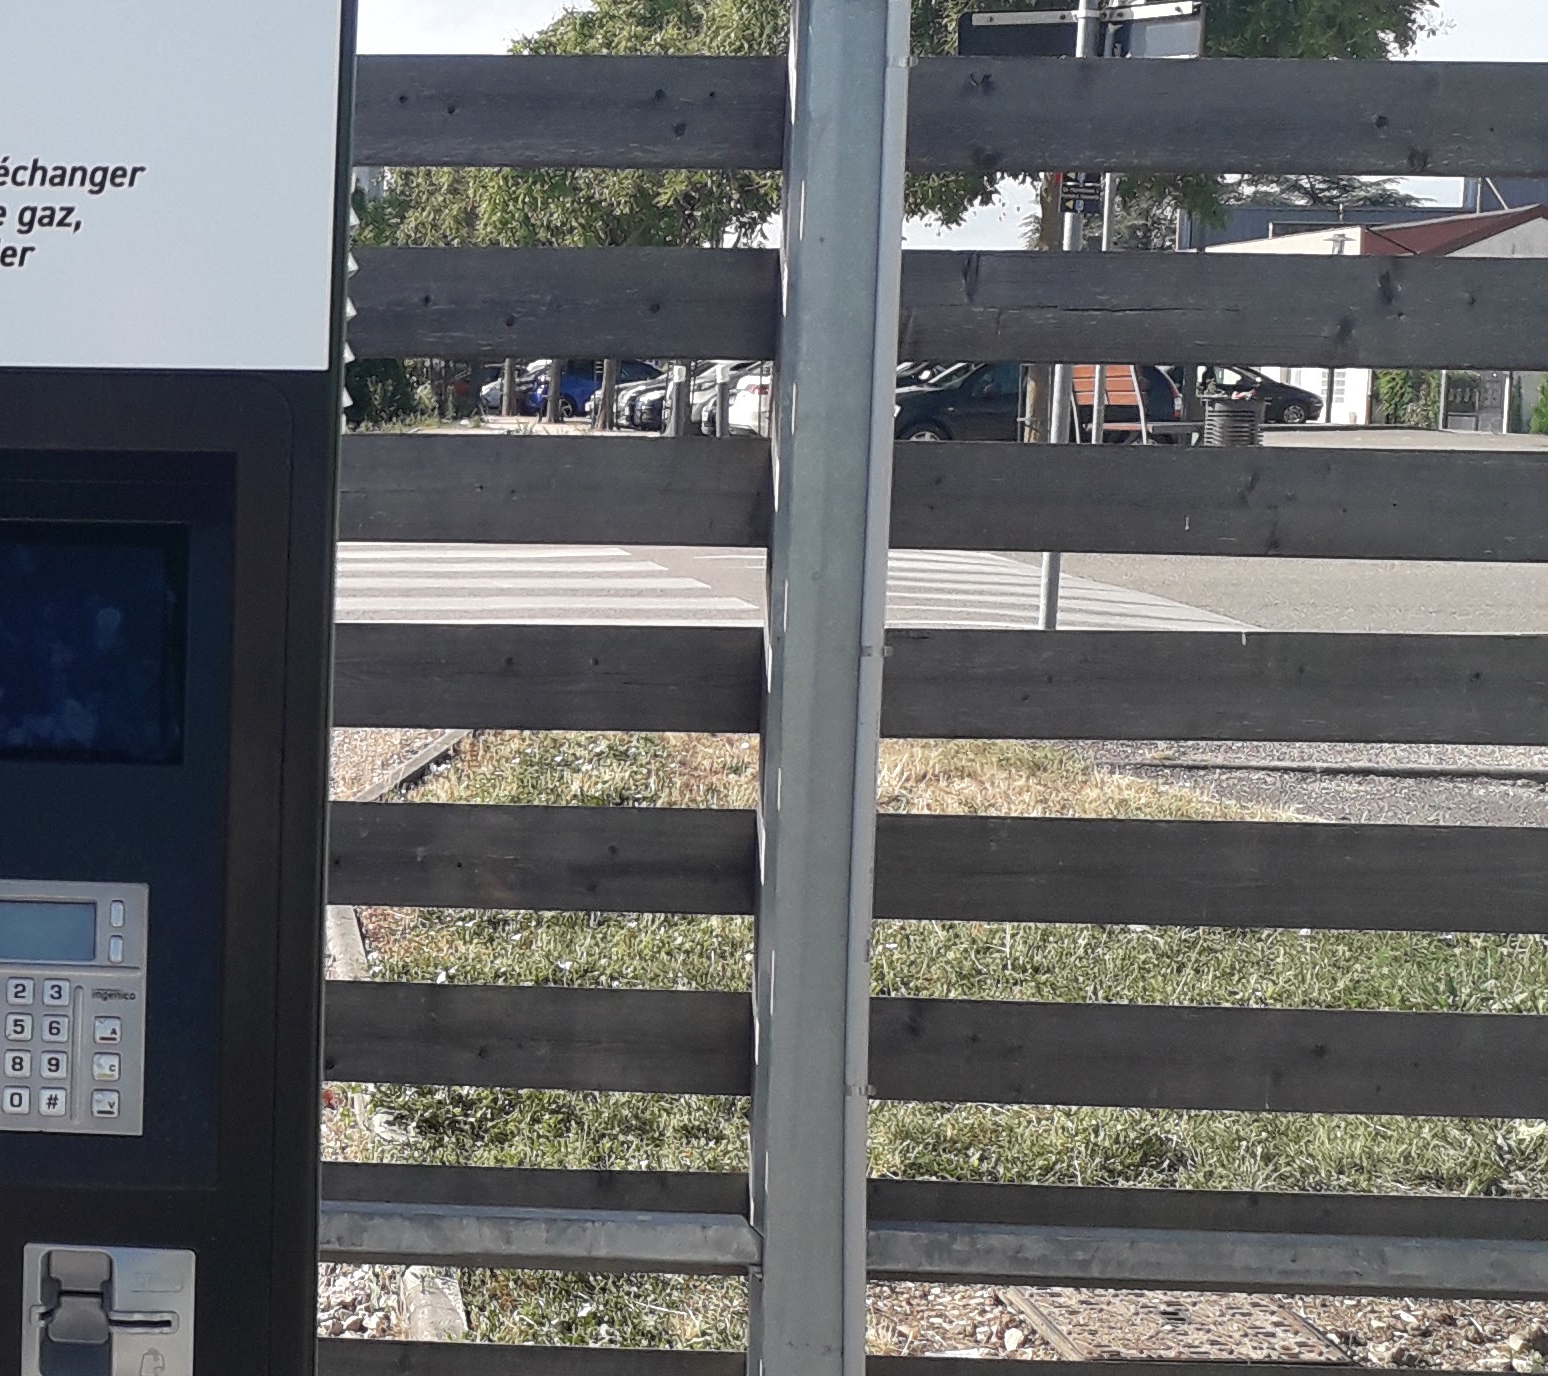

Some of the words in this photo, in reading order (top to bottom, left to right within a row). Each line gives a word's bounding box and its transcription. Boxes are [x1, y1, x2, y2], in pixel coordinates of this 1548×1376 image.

[16, 205, 82, 235] gaz,
[13, 983, 27, 999] 2
[49, 984, 63, 1000] 3
[12, 1018, 25, 1035] 5
[48, 1020, 61, 1036] 6
[11, 1055, 24, 1072] 8
[47, 1056, 60, 1073] 9
